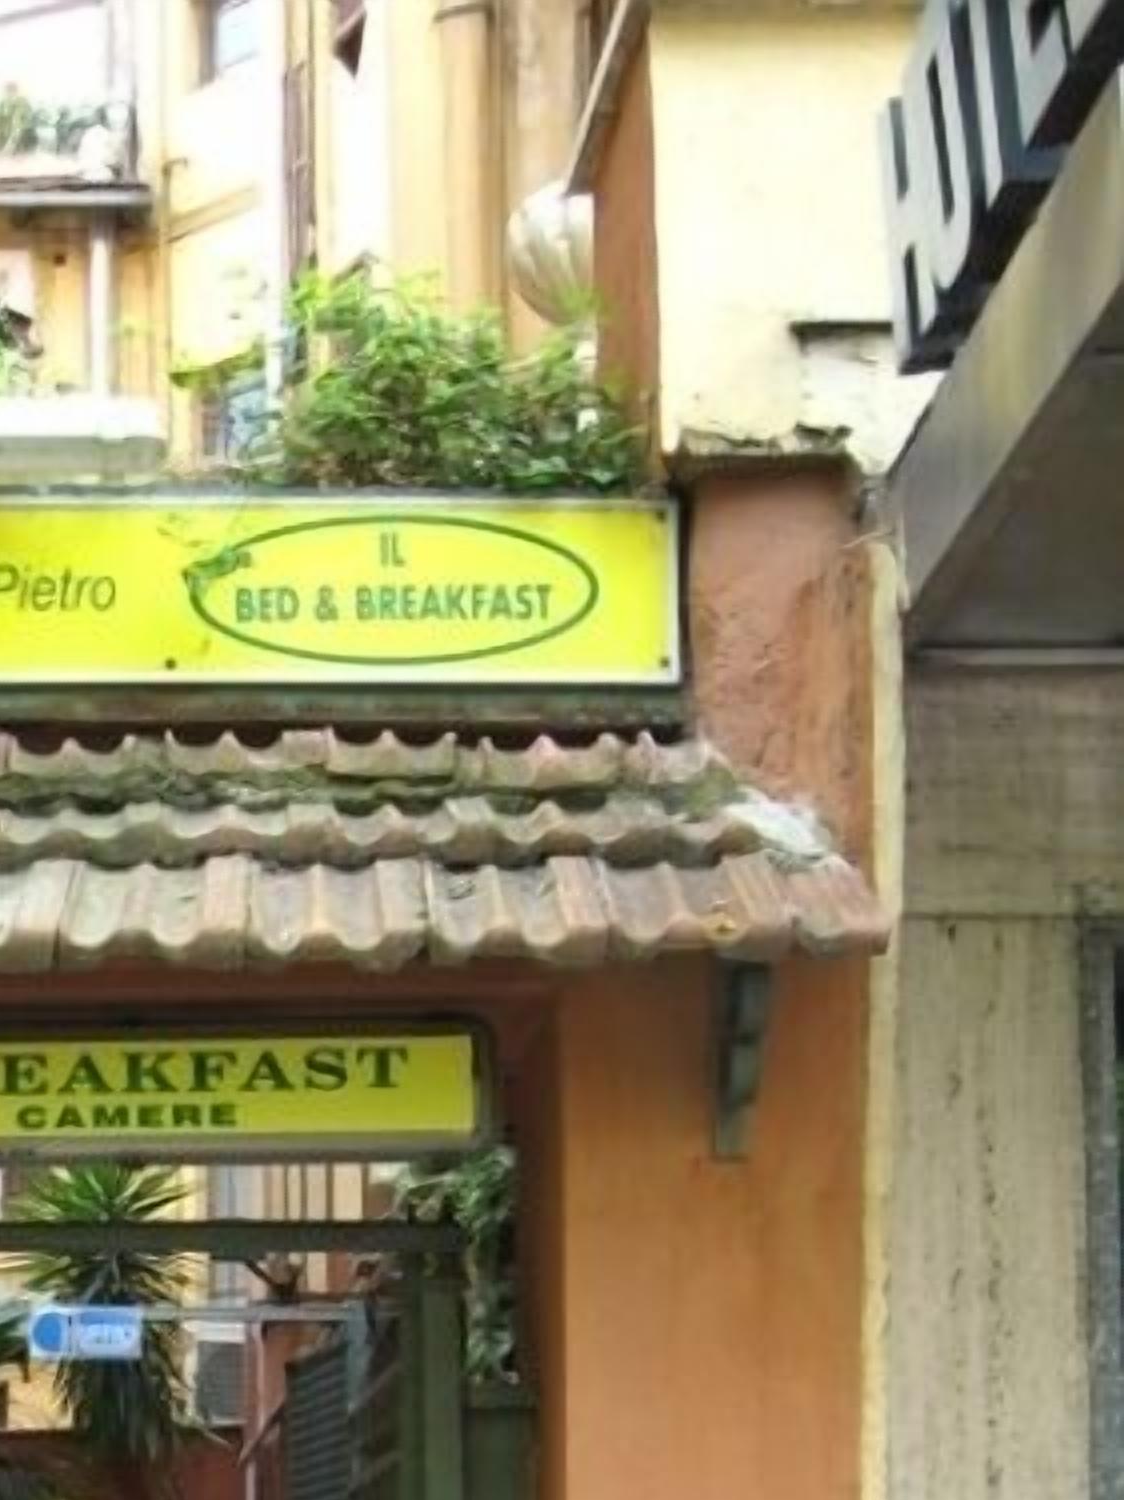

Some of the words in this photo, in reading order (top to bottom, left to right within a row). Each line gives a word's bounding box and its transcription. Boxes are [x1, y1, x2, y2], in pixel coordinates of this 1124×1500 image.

[380, 532, 406, 567] IL
[236, 587, 300, 622] BED
[314, 585, 339, 621] &
[355, 583, 553, 621] BREAKFAST
[16, 1103, 238, 1130] CAMERE
